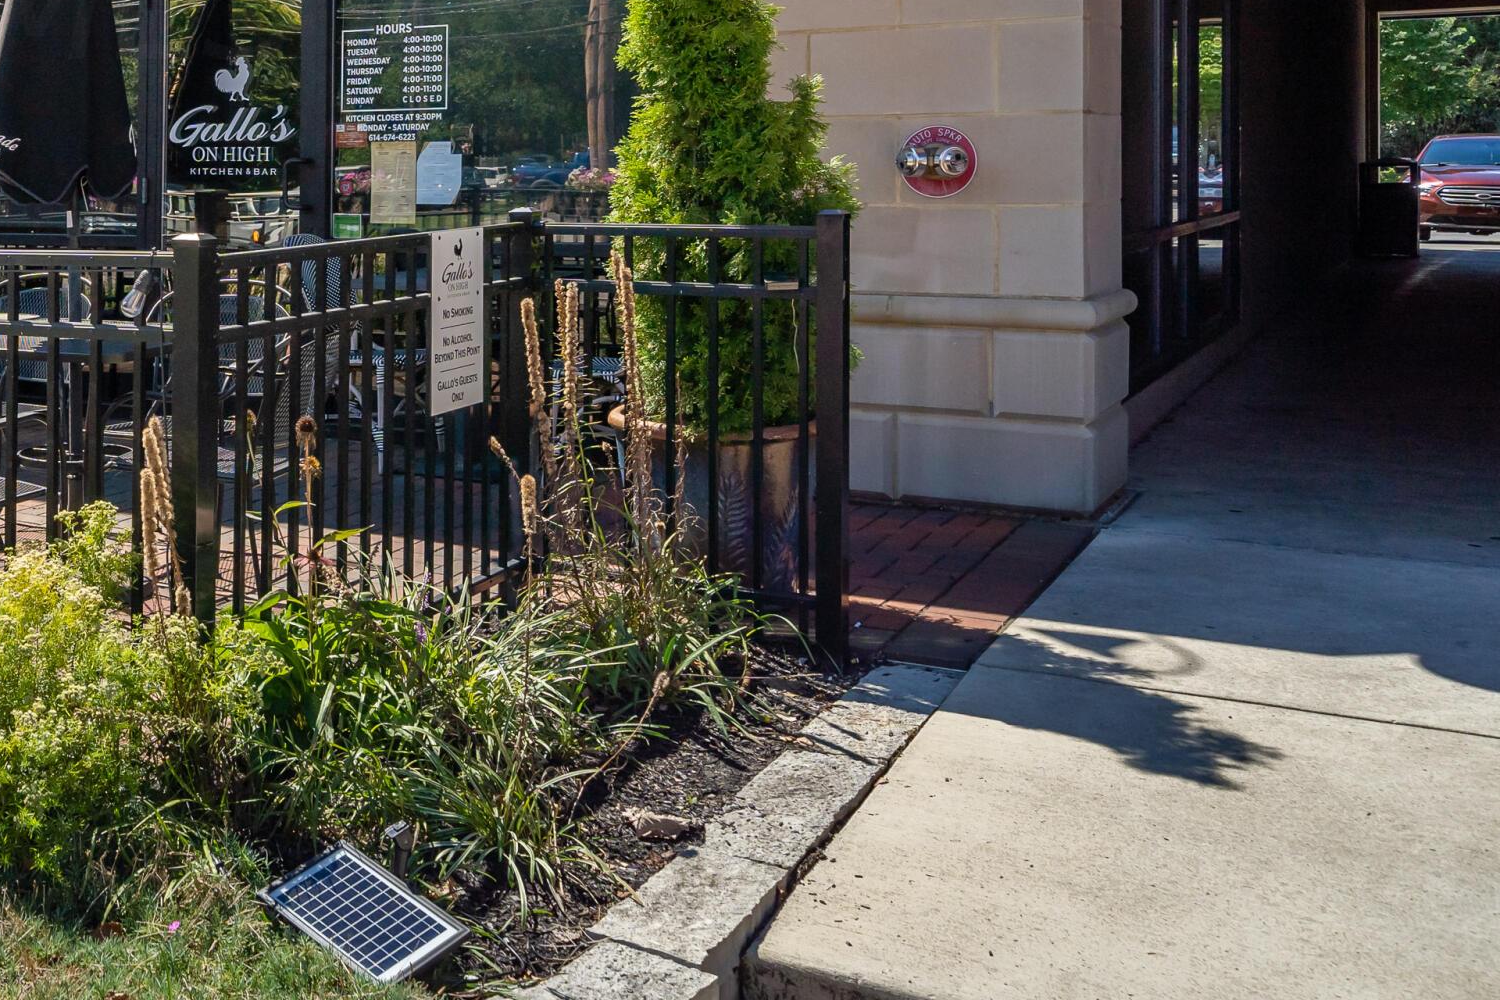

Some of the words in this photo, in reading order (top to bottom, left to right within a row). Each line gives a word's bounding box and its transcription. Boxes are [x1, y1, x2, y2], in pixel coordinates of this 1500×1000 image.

[376, 23, 412, 35] HOURS
[346, 38, 377, 46] MONDAY
[402, 34, 443, 43] 4:00-10:00
[346, 48, 378, 56] TUESDAY
[402, 44, 443, 53] 4:00-10:00
[347, 57, 391, 66] WEDNESDAY
[402, 55, 443, 63] 4:00-10:00
[346, 67, 384, 76] THURSDAY
[402, 65, 443, 73] 4:00-10:00
[346, 77, 372, 86] FRIDAY
[402, 75, 443, 83] 4:00-11:00
[346, 87, 383, 95] SATURDAY
[402, 85, 443, 93] 4:00-11:00
[346, 97, 375, 105] SUNDAY
[346, 114, 376, 122] KITCHEN
[377, 113, 403, 121] CLOSES
[405, 113, 414, 121] AT
[415, 112, 442, 121] 9:30PM
[169, 104, 296, 147] Gallo's
[392, 123, 430, 131] SATURDAY
[368, 133, 416, 142] 614-674-6223
[937, 128, 962, 143] SPKR
[192, 146, 218, 162] ON
[223, 146, 270, 162] HIGH
[442, 260, 474, 285] Gallo's
